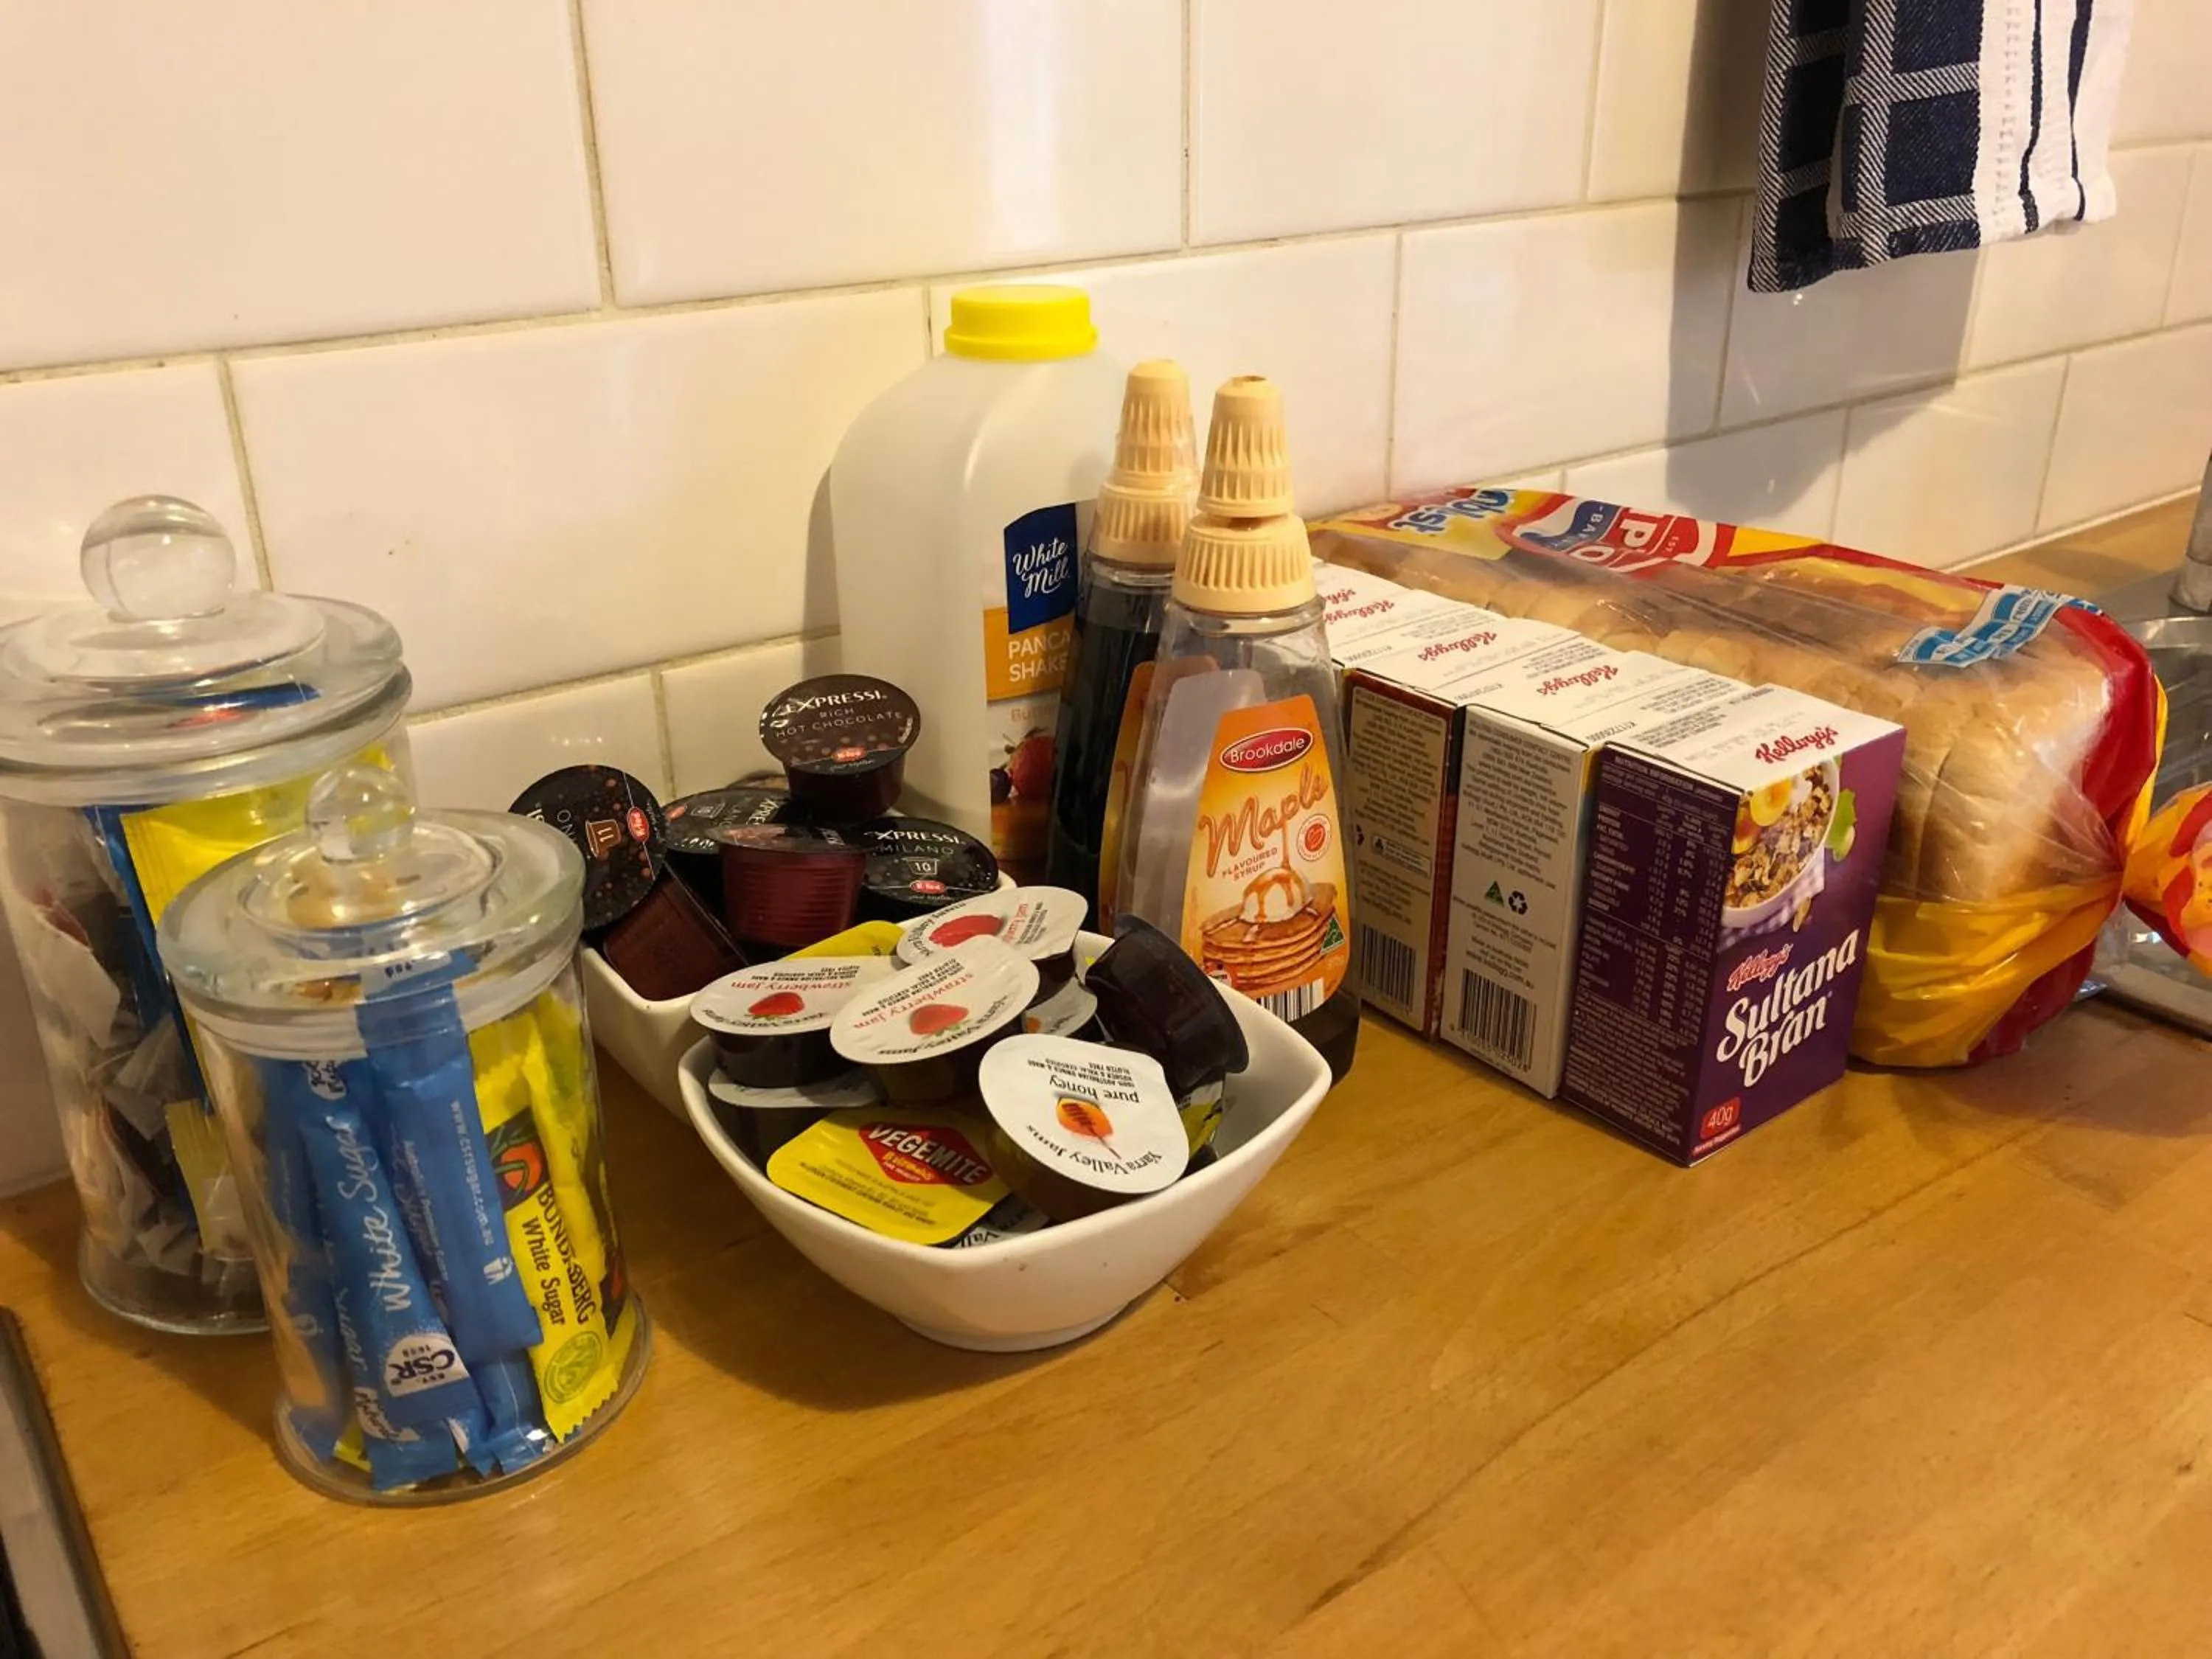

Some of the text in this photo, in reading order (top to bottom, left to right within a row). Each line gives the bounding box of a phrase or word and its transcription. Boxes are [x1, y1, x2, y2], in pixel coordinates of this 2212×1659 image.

[1013, 536, 1068, 576] White
[1022, 557, 1070, 599] Mill
[1417, 630, 1498, 661] Kellogg's
[1535, 664, 1619, 697] Kellogg's
[776, 710, 902, 738] HOT CHOCOLATE
[1228, 736, 1306, 765] Brookdale
[1756, 726, 1839, 764] Kellogg's
[872, 830, 961, 846] XPRESSI
[1199, 762, 1329, 879] Maple
[880, 844, 955, 855] MILANO
[914, 861, 932, 873] 10
[1221, 846, 1279, 877] FLAVOURED
[1233, 860, 1267, 883] SYRUP
[731, 980, 853, 992] strawberry jam
[1726, 942, 1795, 993] Kellogg's
[852, 971, 975, 1031] strawberry jam
[1717, 928, 1860, 1063] Sultana
[1739, 999, 1827, 1088] Bran
[1048, 1074, 1140, 1105] pure honey
[1706, 1103, 1736, 1128] 40g
[324, 1114, 379, 1203] Sugar
[866, 1122, 990, 1186] VEGEMITE
[1026, 1124, 1163, 1175] Yarra Valley Jams
[958, 1227, 999, 1250] Vall
[369, 1204, 412, 1314] White
[521, 1214, 566, 1326] White Sugar
[387, 1346, 457, 1387] CSR
